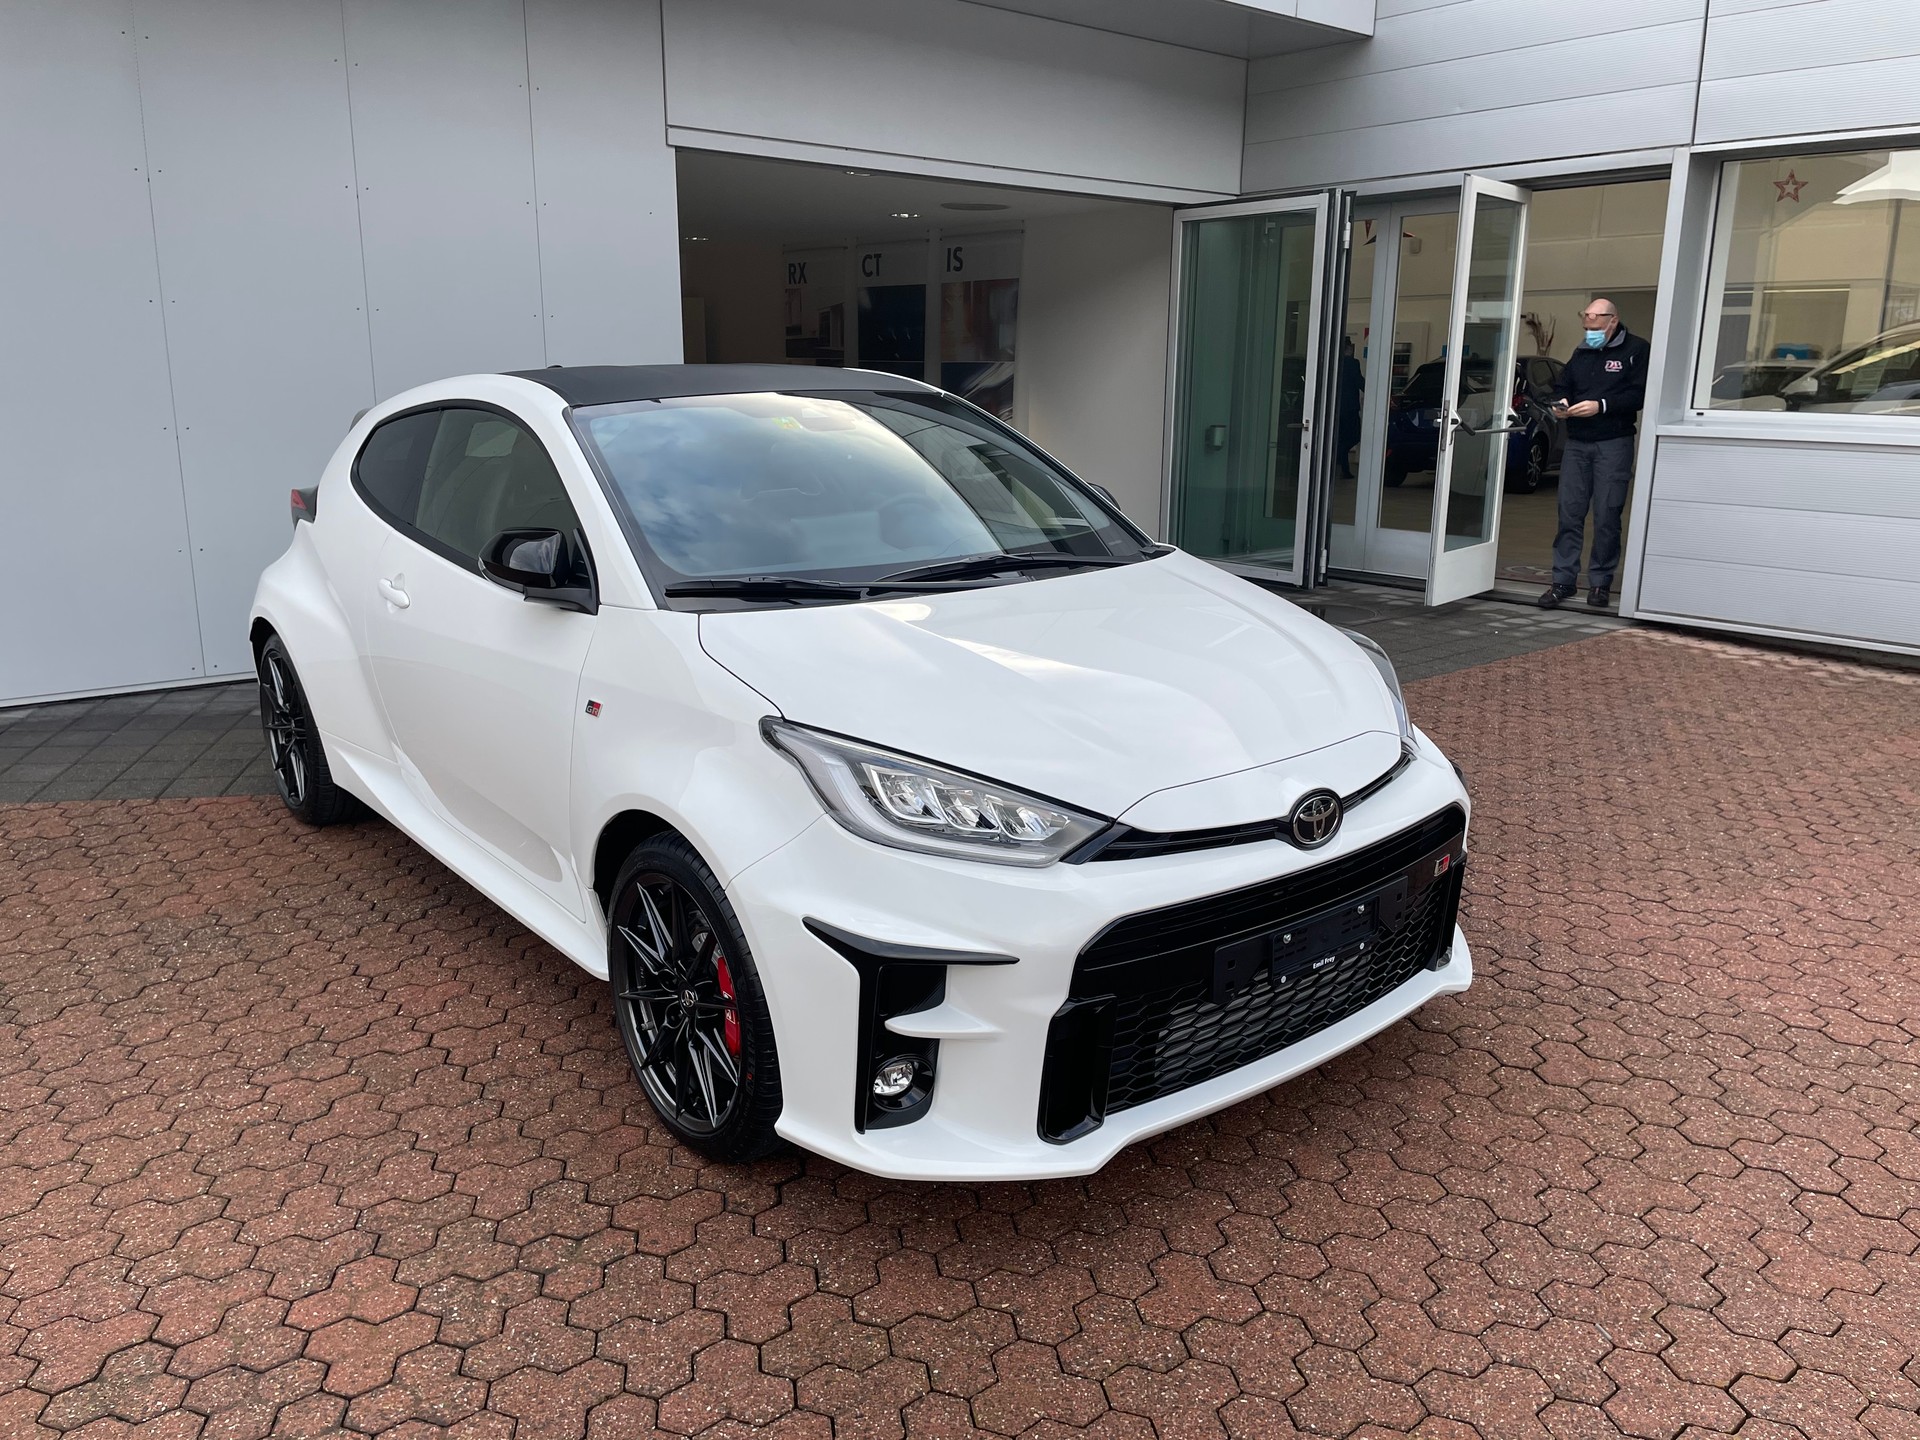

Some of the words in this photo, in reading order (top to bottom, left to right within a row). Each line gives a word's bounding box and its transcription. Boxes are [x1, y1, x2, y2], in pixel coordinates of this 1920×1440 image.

[861, 253, 882, 278] CT
[946, 246, 963, 272] IS
[788, 262, 808, 285] RX
[586, 705, 599, 716] GR
[1312, 959, 1324, 969] Emil
[1324, 955, 1336, 965] Frey
